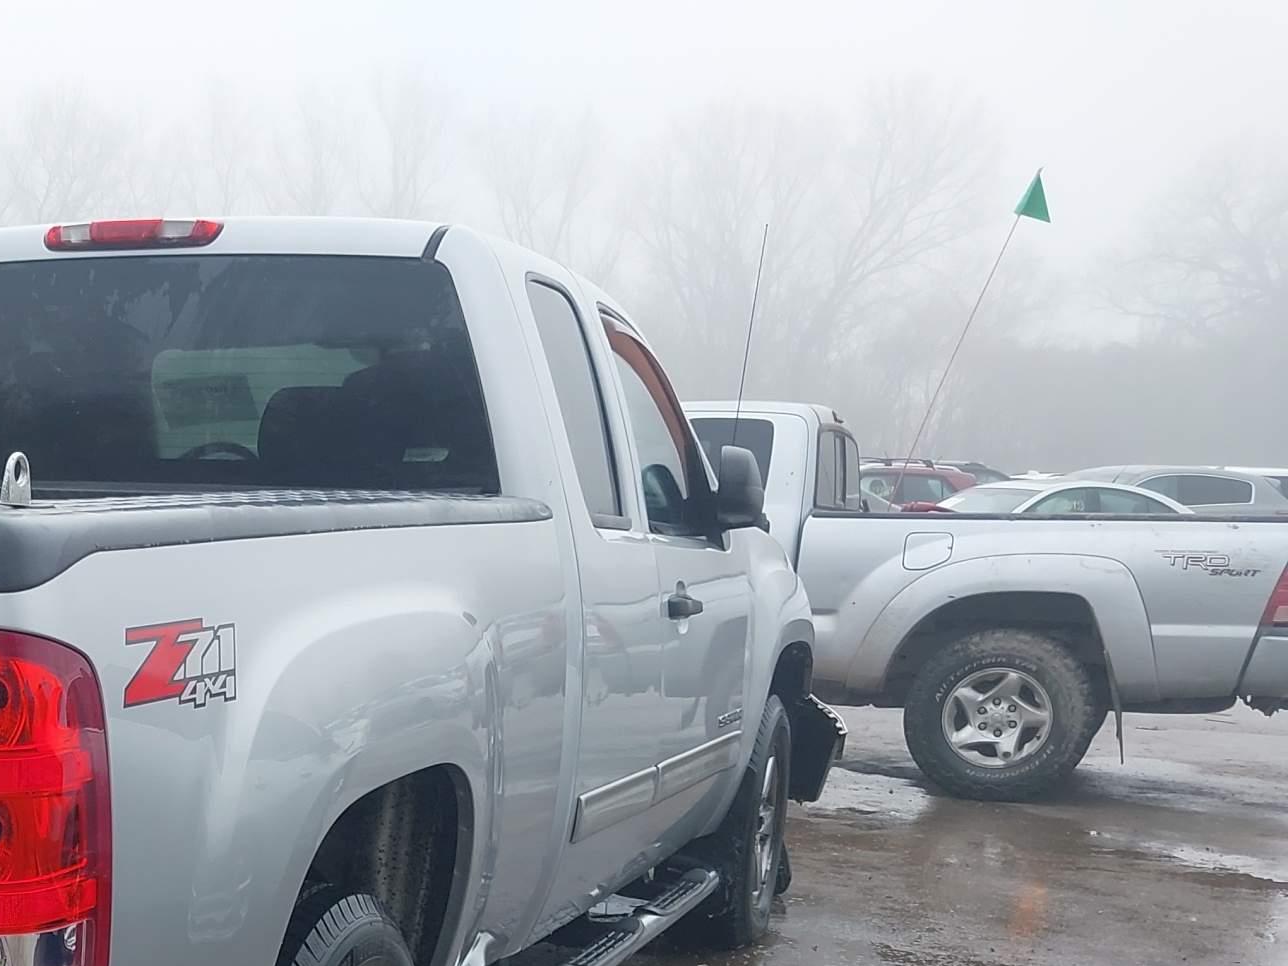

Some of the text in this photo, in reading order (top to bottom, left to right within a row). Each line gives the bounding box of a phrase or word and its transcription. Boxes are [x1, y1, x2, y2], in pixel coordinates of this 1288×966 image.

[1161, 553, 1262, 578] TRD SPORT
[122, 617, 236, 709] Z71
